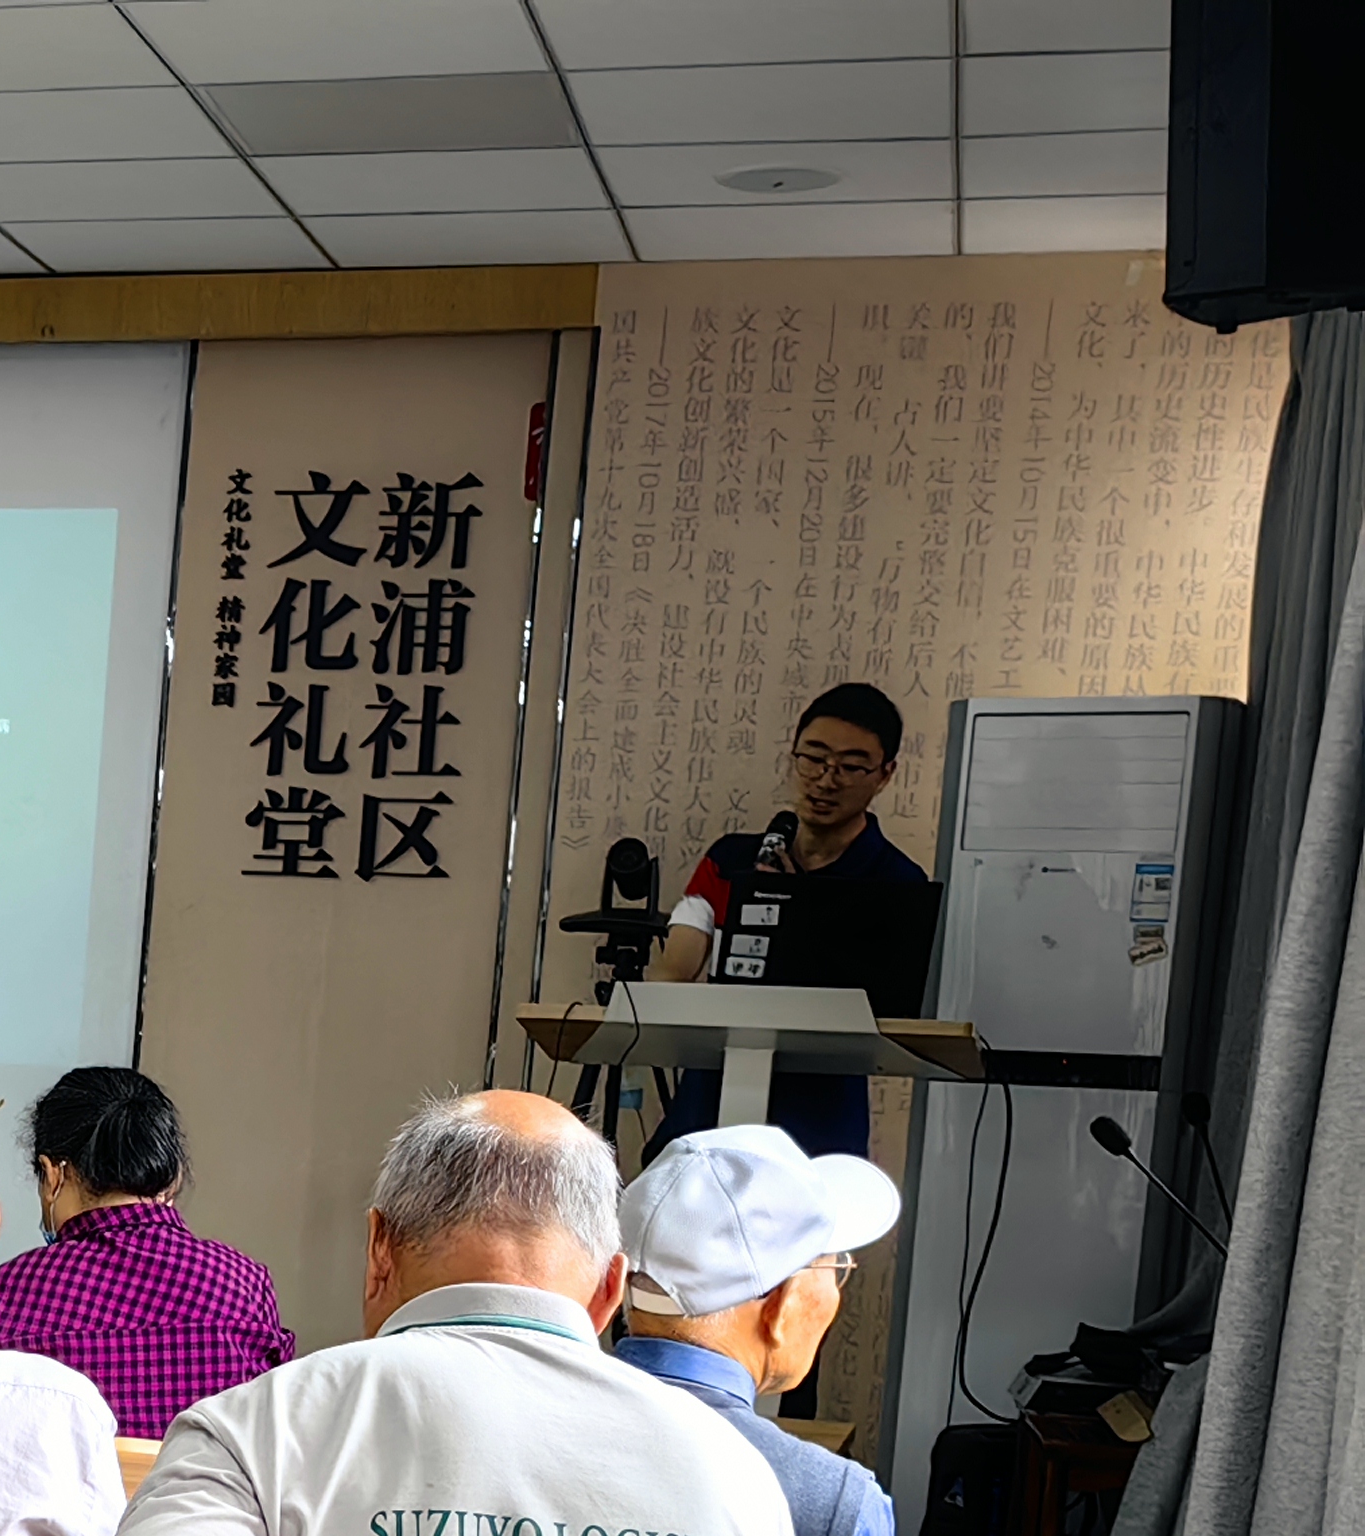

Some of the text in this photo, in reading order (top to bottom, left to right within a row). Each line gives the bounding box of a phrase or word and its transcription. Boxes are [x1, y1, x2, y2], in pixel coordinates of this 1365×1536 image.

[212, 468, 254, 709] 文化礼堂 精神家园
[241, 470, 371, 881] 文化礼堂
[353, 471, 484, 882] 新浦社区
